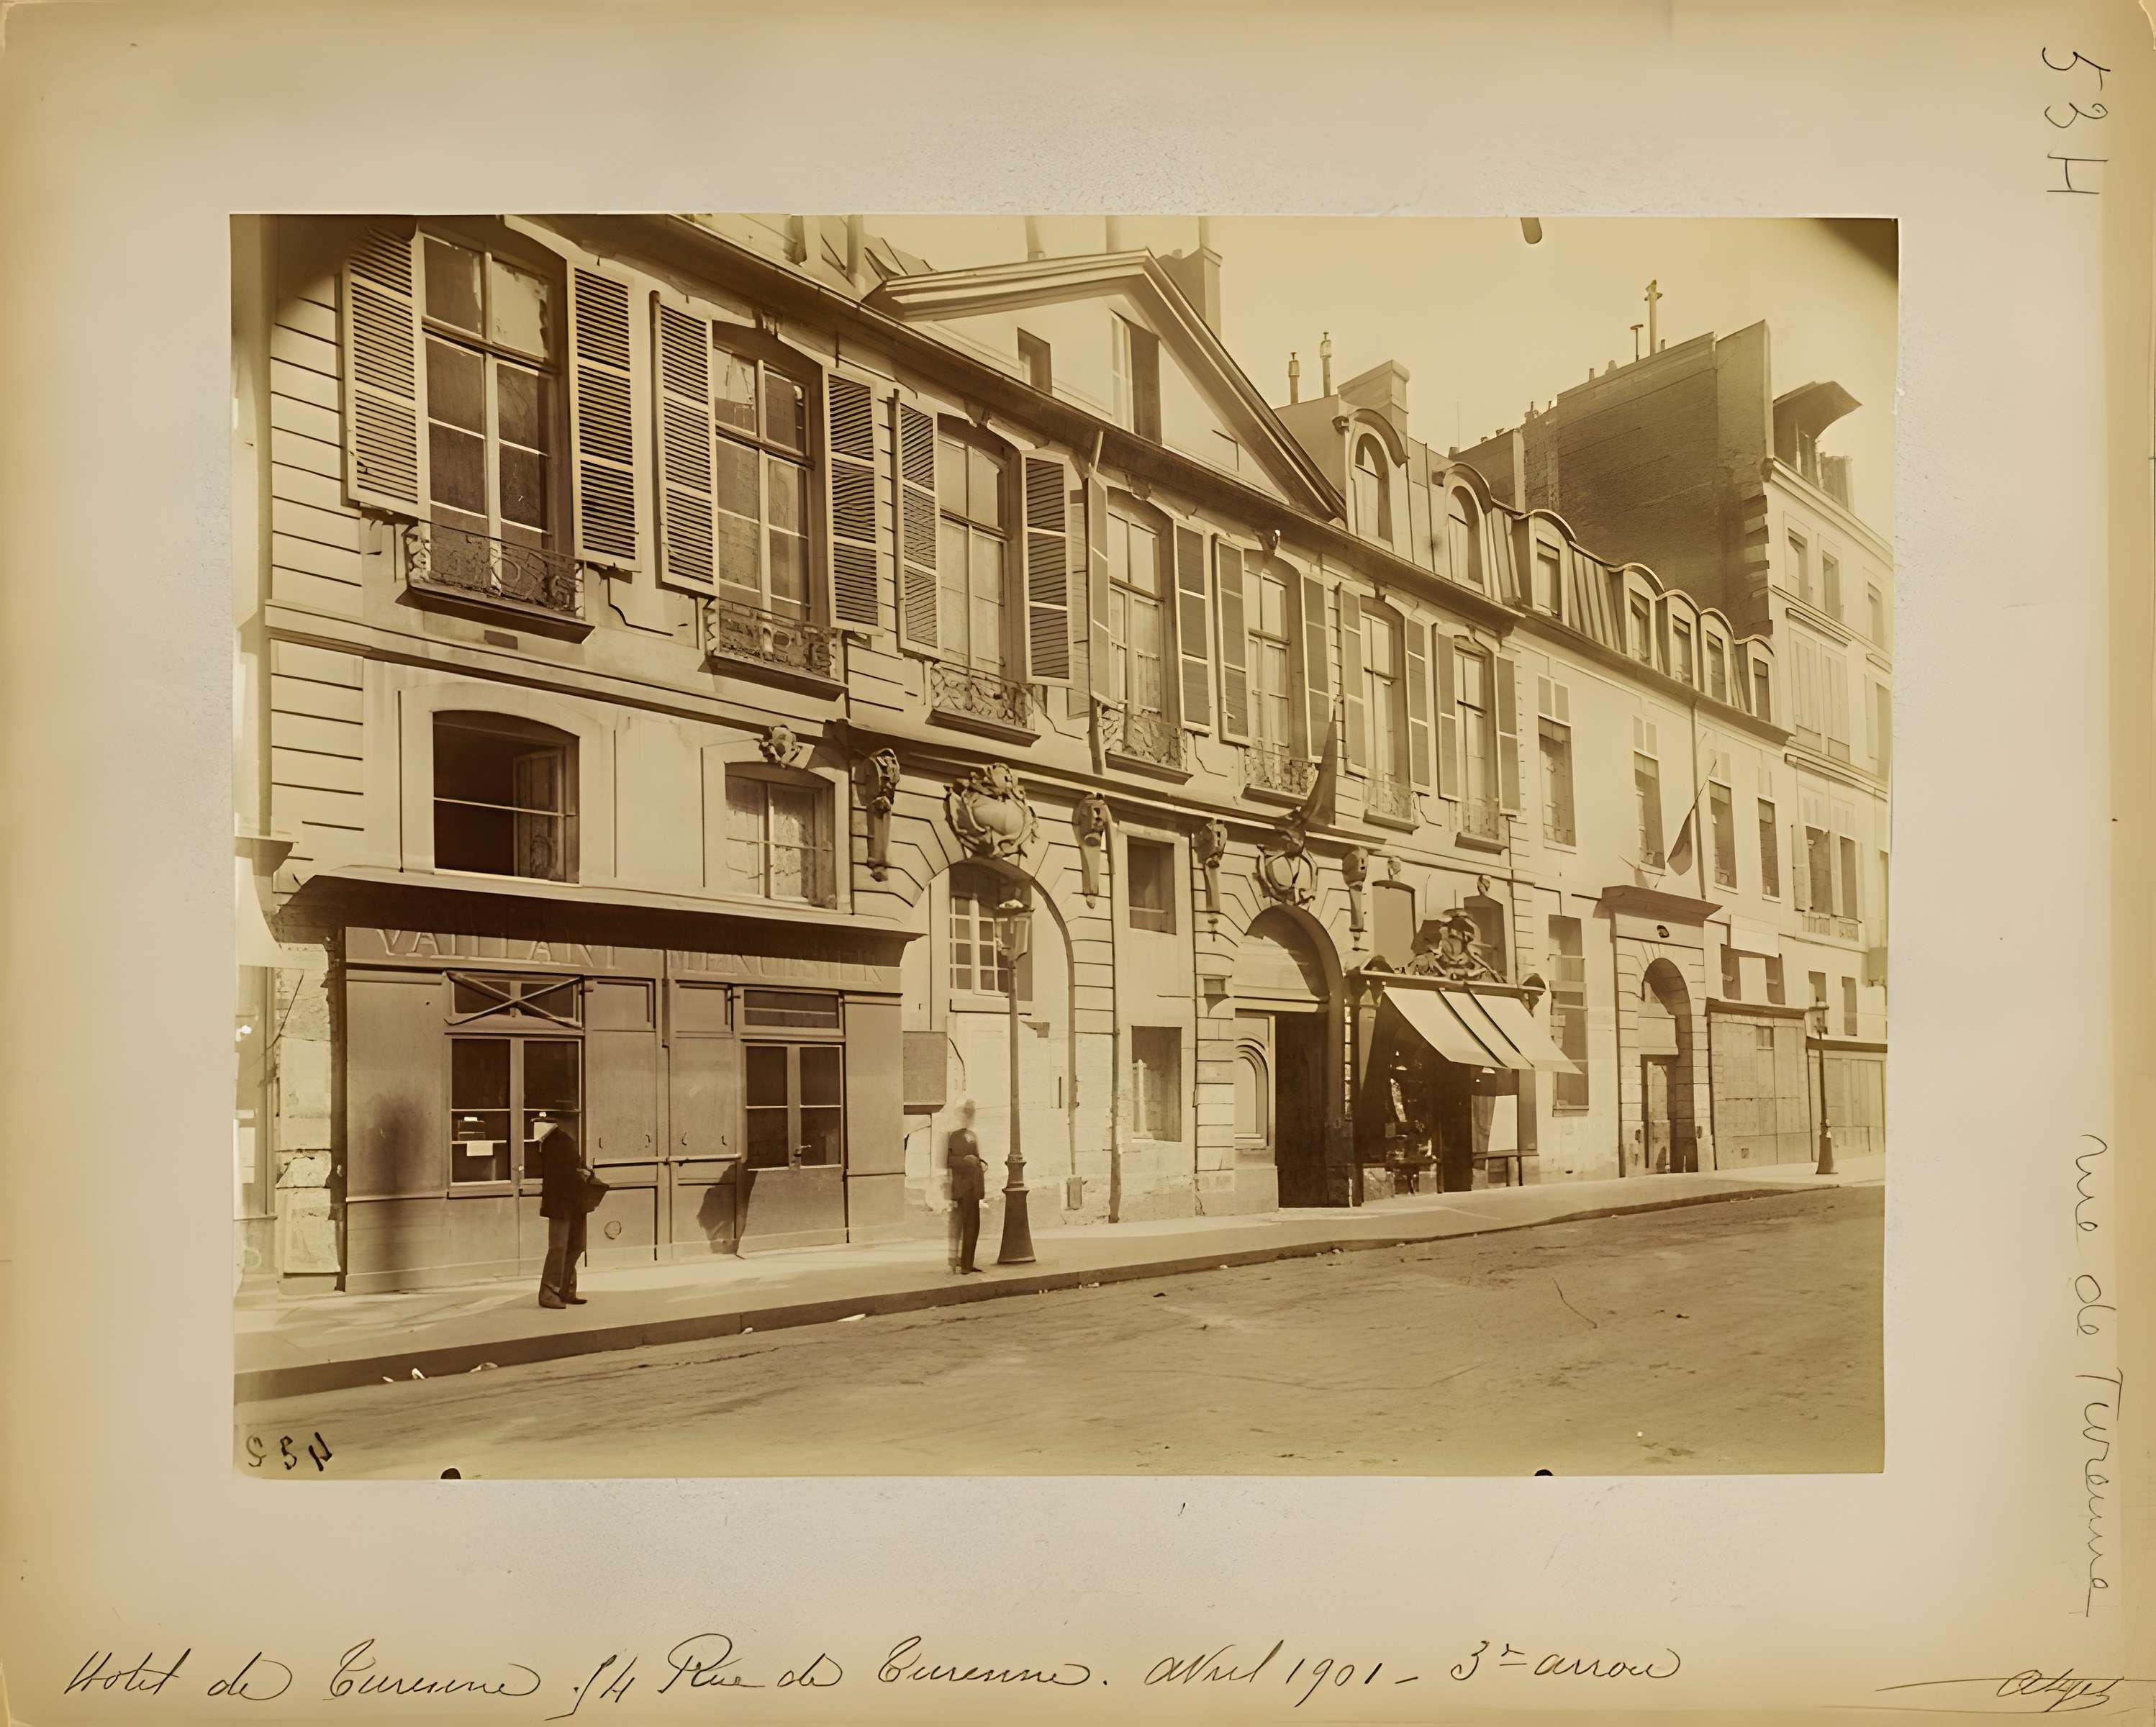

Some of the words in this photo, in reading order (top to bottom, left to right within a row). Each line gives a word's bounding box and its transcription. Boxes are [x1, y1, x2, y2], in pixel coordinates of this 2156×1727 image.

[2075, 1134, 2108, 1251] rue
[2075, 1274, 2117, 1336] de
[2074, 1367, 2124, 1618] Turenne
[207, 1651, 293, 1701] de
[322, 1638, 541, 1701] Turenne
[656, 1633, 766, 1694] Rue
[777, 1652, 843, 1688] de
[1285, 1658, 1383, 1708] 1901
